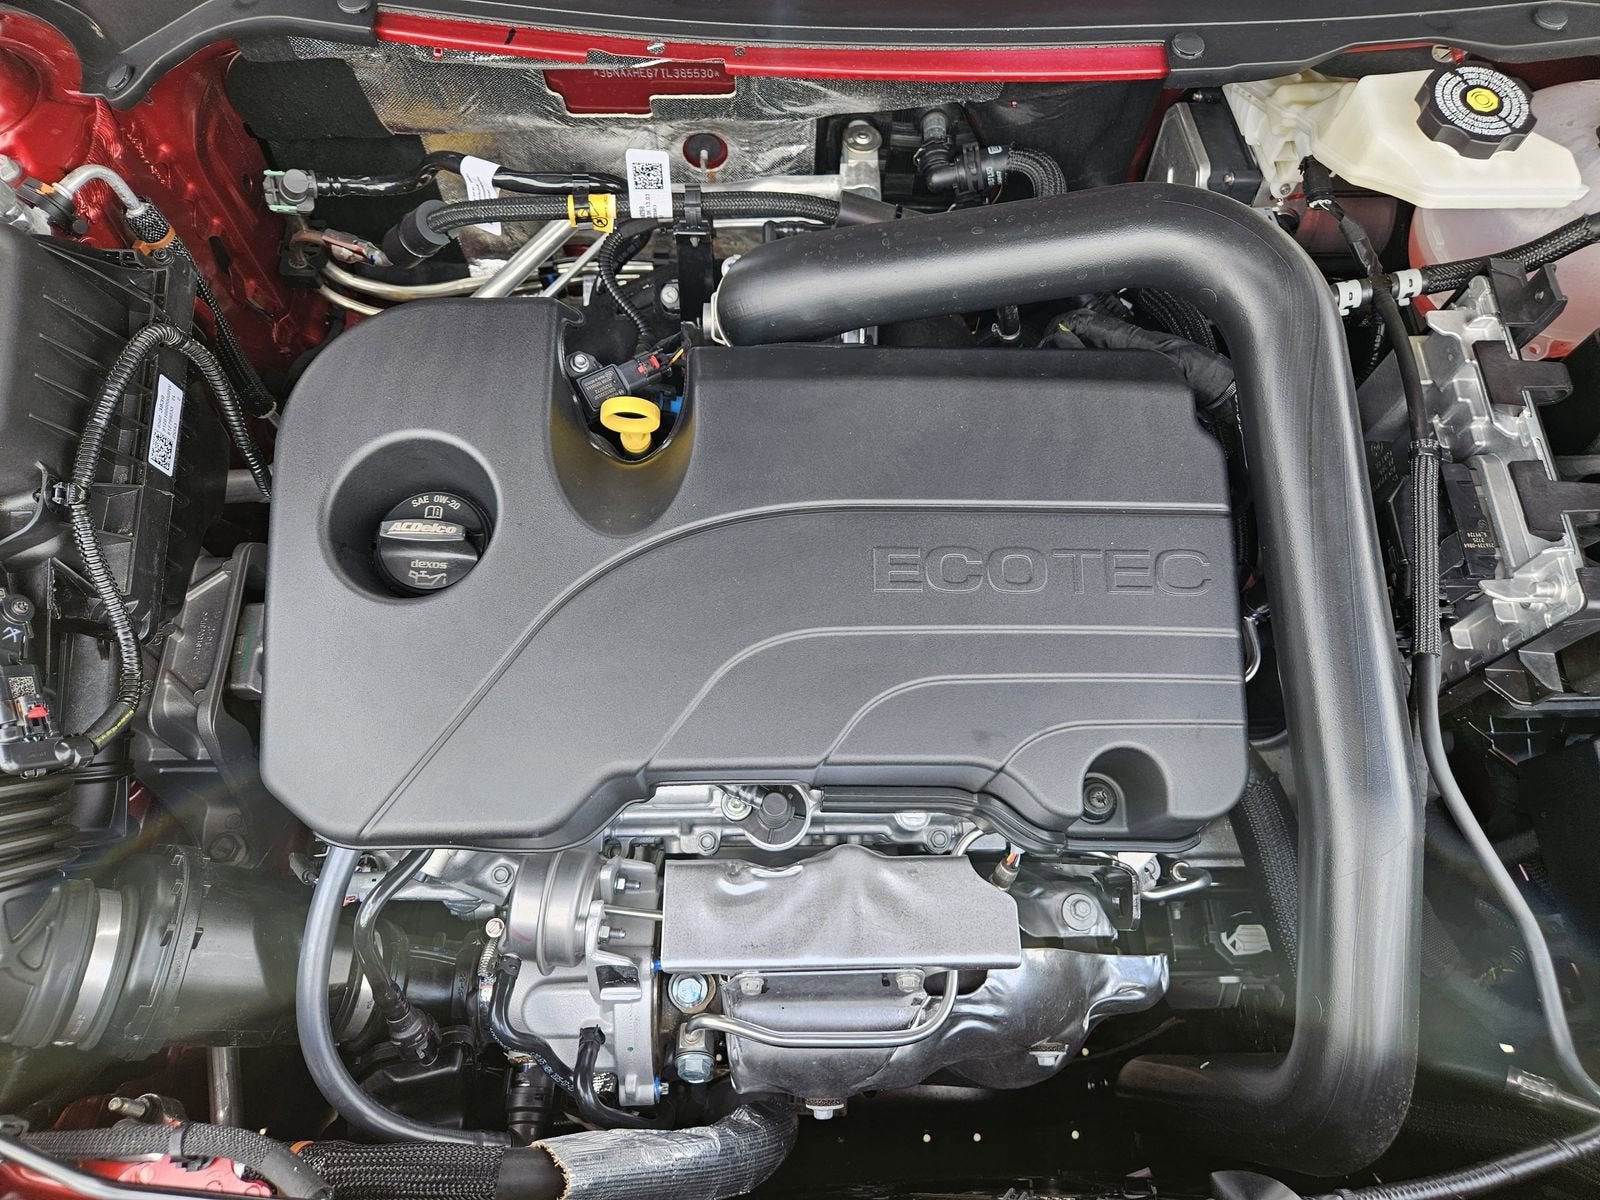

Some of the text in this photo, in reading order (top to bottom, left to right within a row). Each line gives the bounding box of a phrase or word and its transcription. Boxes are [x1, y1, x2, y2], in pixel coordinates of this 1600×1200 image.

[411, 495, 461, 510] SAE 0W-20
[388, 522, 457, 534] ACDelco
[410, 560, 449, 569] dexos
[872, 546, 1212, 597] ECOTEC
